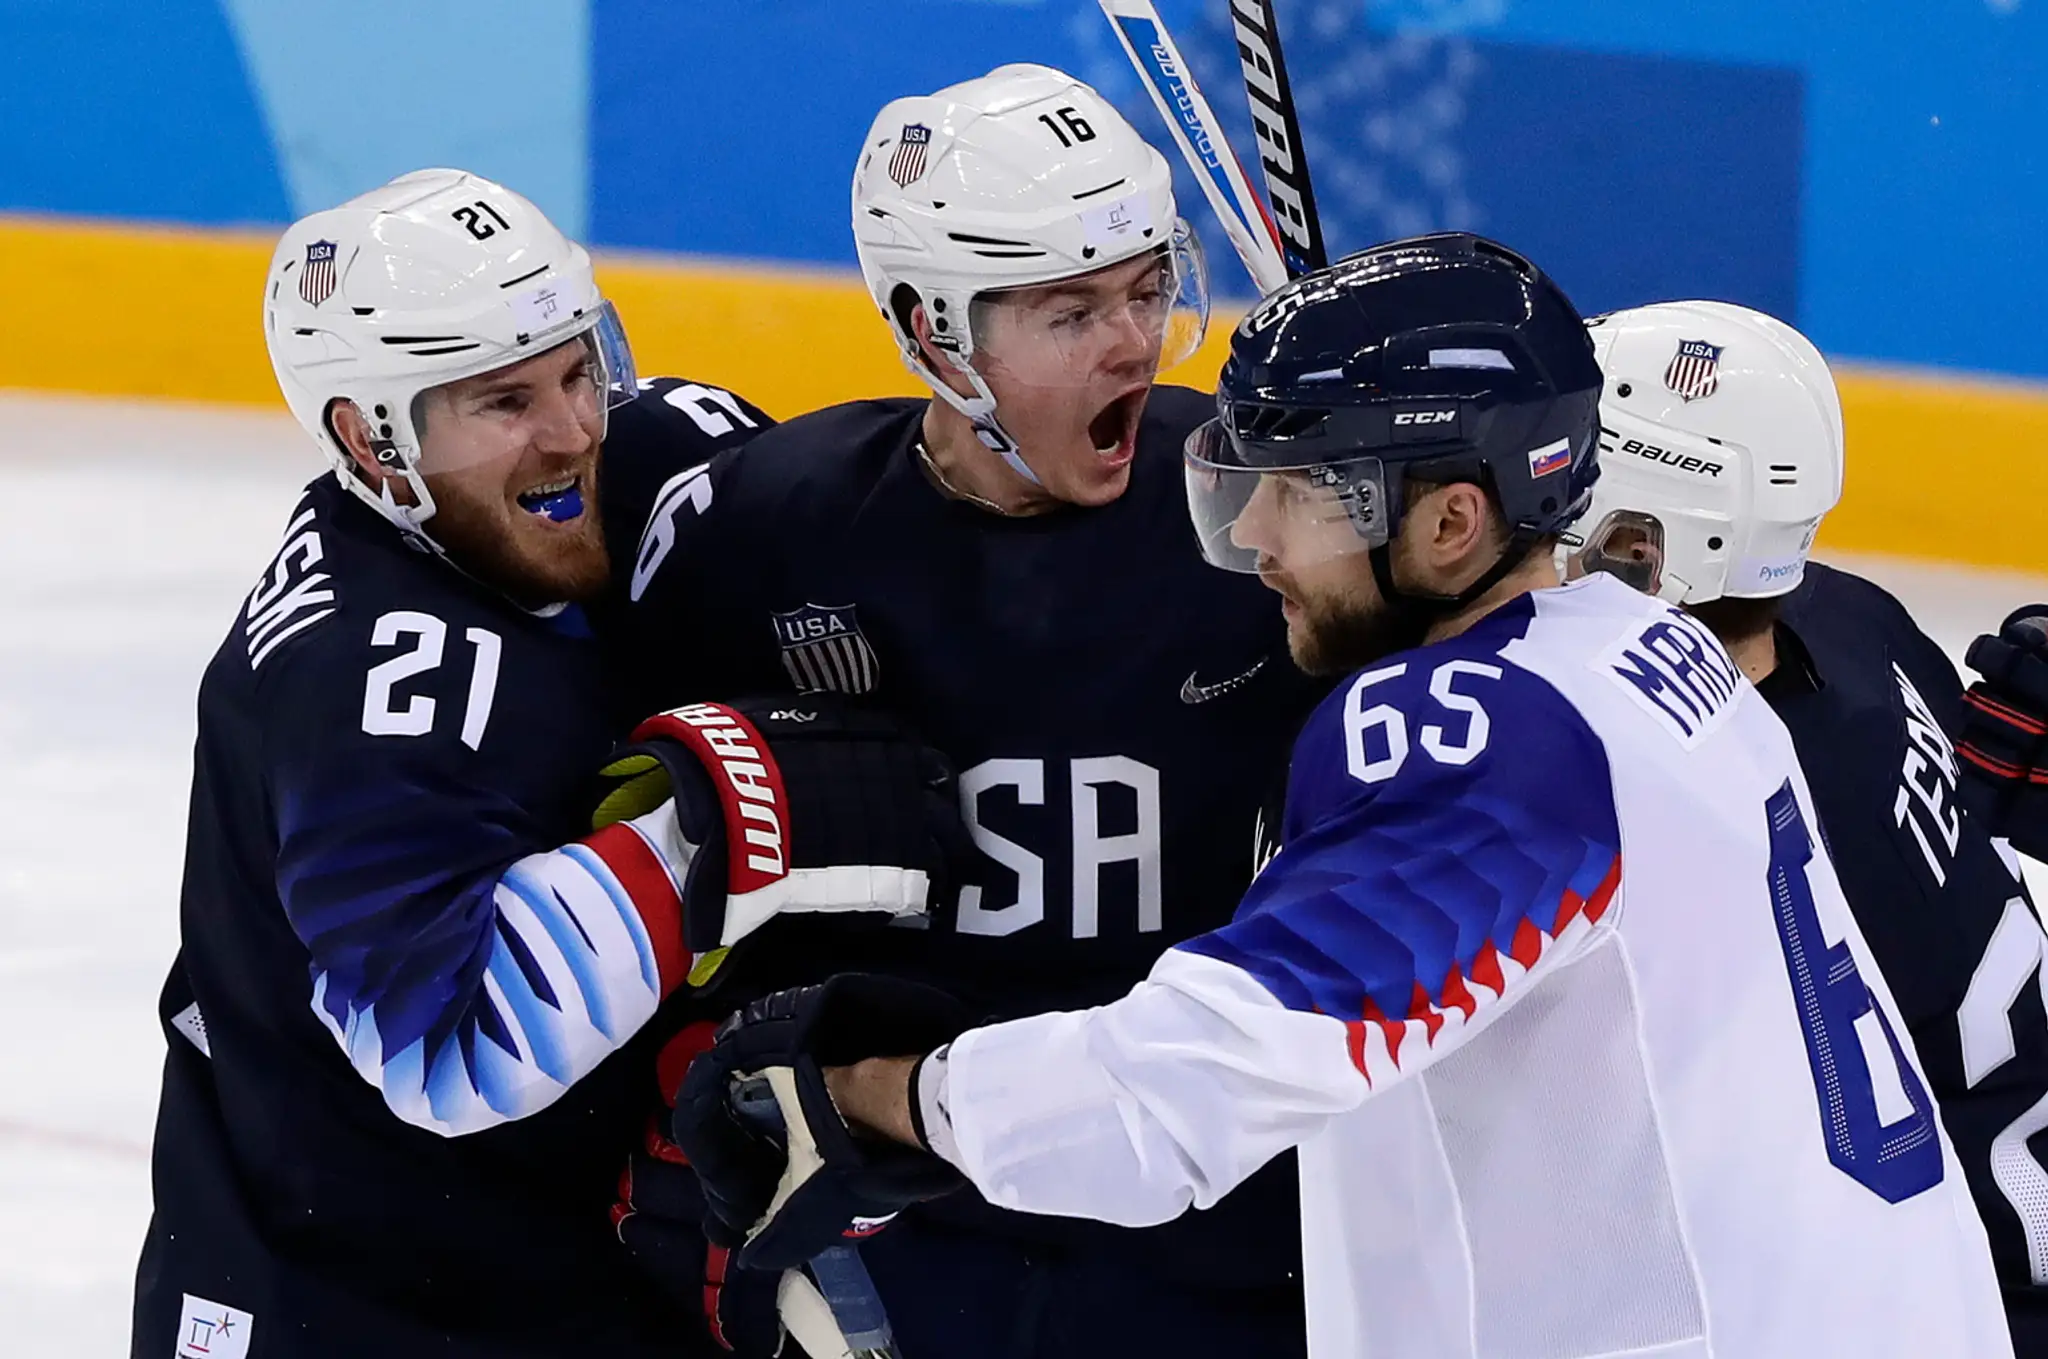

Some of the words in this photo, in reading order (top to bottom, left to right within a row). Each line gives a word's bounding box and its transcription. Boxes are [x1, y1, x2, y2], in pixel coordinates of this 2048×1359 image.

[905, 128, 927, 142] USA
[1037, 106, 1097, 148] 16
[1170, 81, 1220, 168] COVERT
[451, 200, 511, 241] 21
[310, 246, 332, 260] USA
[1683, 342, 1714, 359] USA
[1394, 410, 1456, 425] CCM
[785, 614, 847, 641] USA
[361, 611, 502, 751] 21
[1343, 659, 1503, 784] 65
[956, 754, 1162, 938] SA
